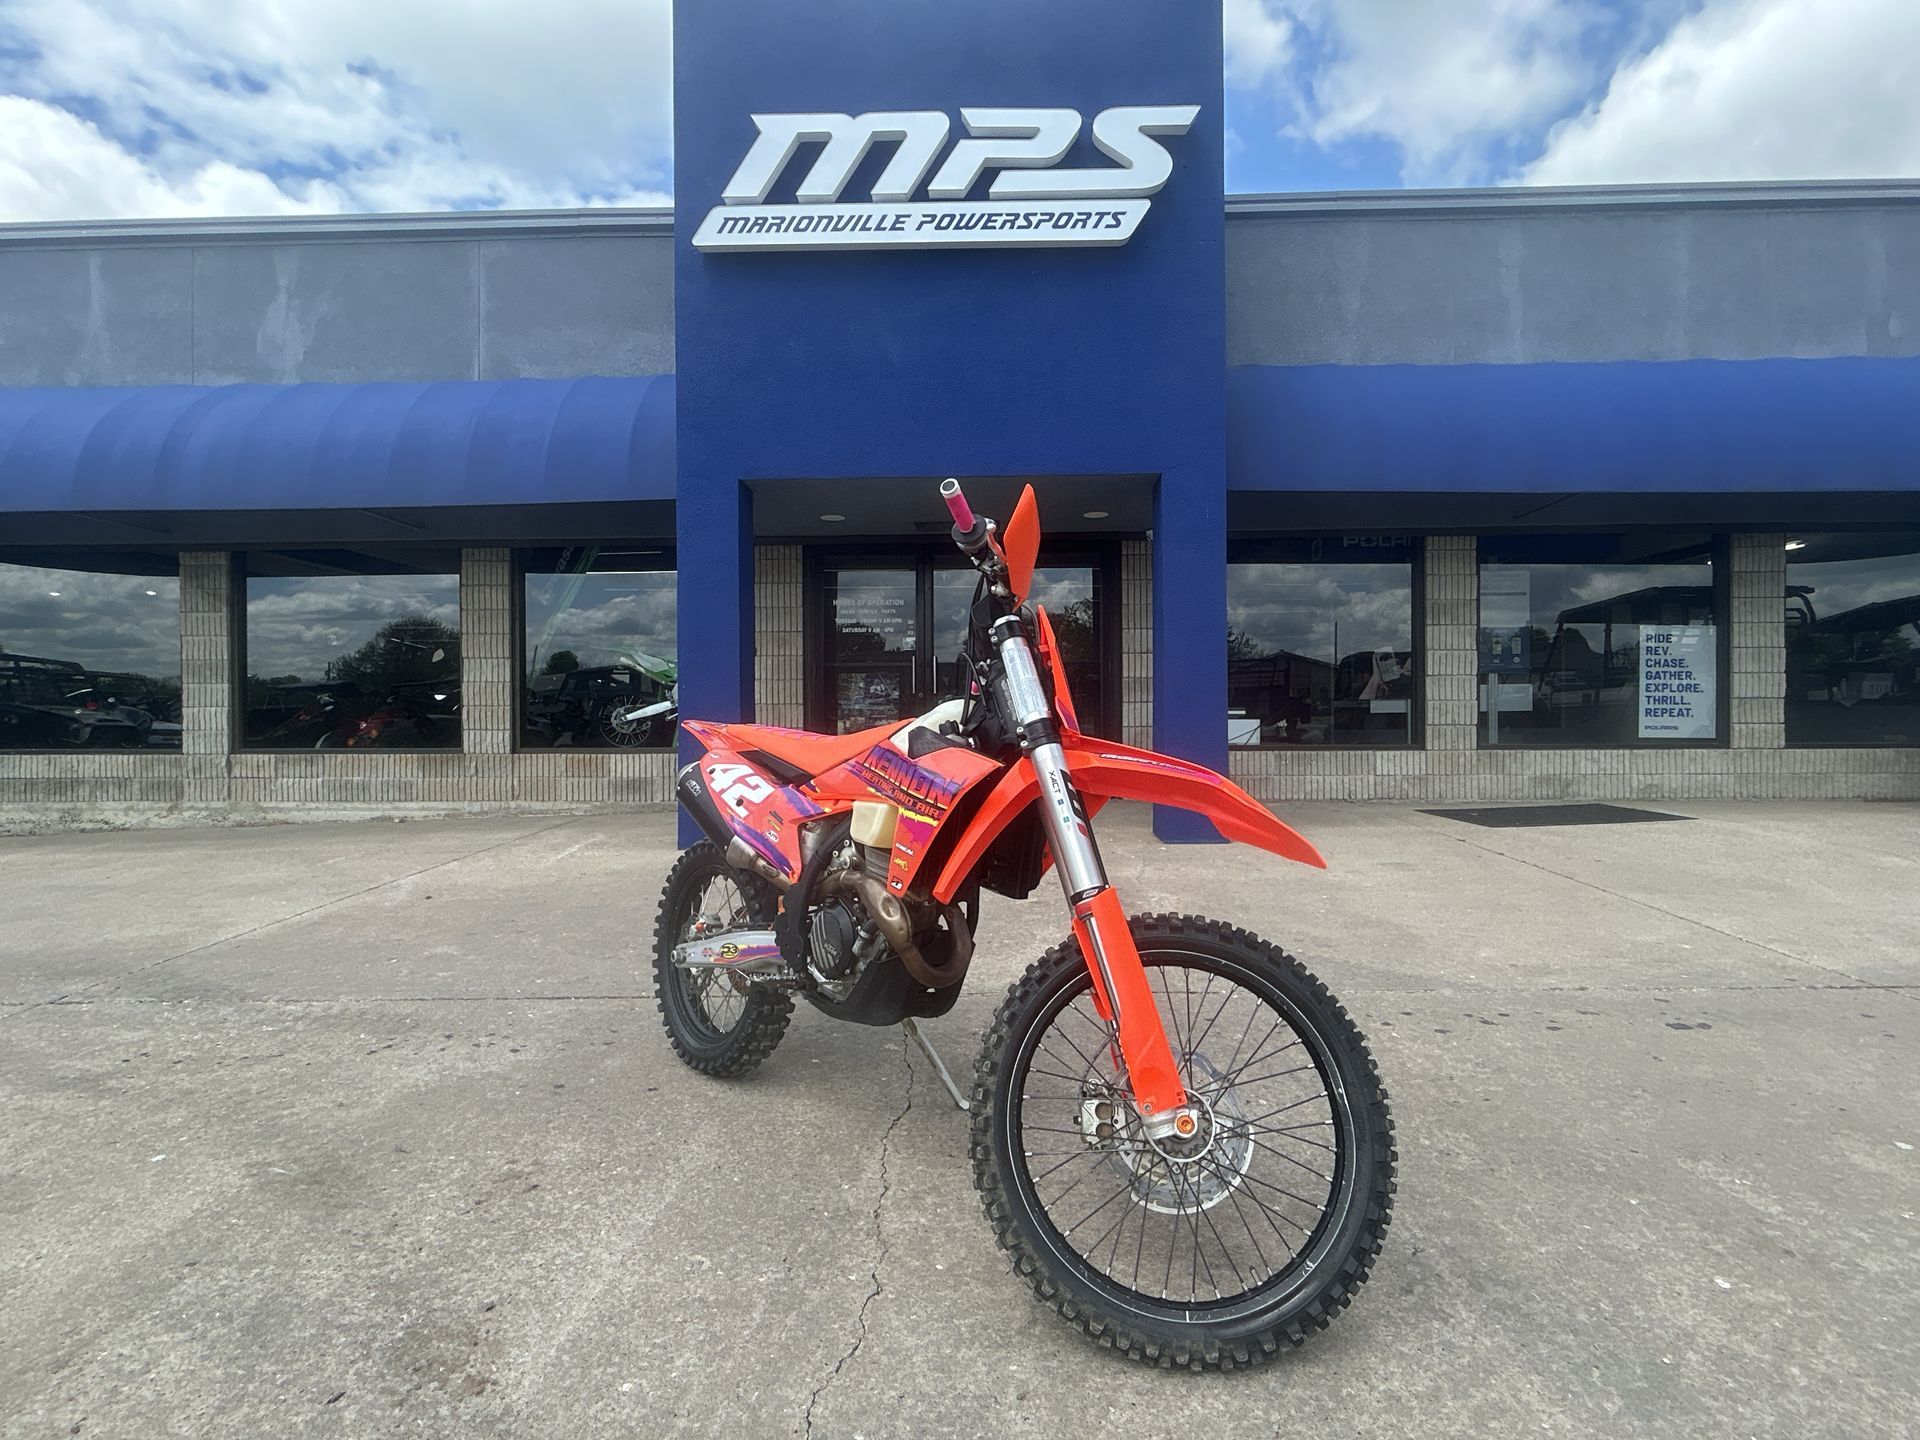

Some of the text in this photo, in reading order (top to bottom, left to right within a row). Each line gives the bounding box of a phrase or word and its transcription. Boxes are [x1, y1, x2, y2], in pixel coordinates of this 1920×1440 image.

[721, 105, 1201, 203] MPS
[717, 210, 1128, 234] MARIONVILLE POWERSPORTS
[1645, 646, 1672, 656] REV.
[1645, 658, 1689, 668] CHASE.
[1645, 670, 1696, 681] GATHER.
[1645, 683, 1704, 693] EXPLORE.
[1645, 695, 1691, 705] THRILL.
[1645, 708, 1694, 718] REPEAT.
[863, 744, 961, 810] KENNON
[1048, 769, 1062, 794] XACT
[706, 763, 775, 819] 42
[861, 769, 940, 819] HEATING AND AIR
